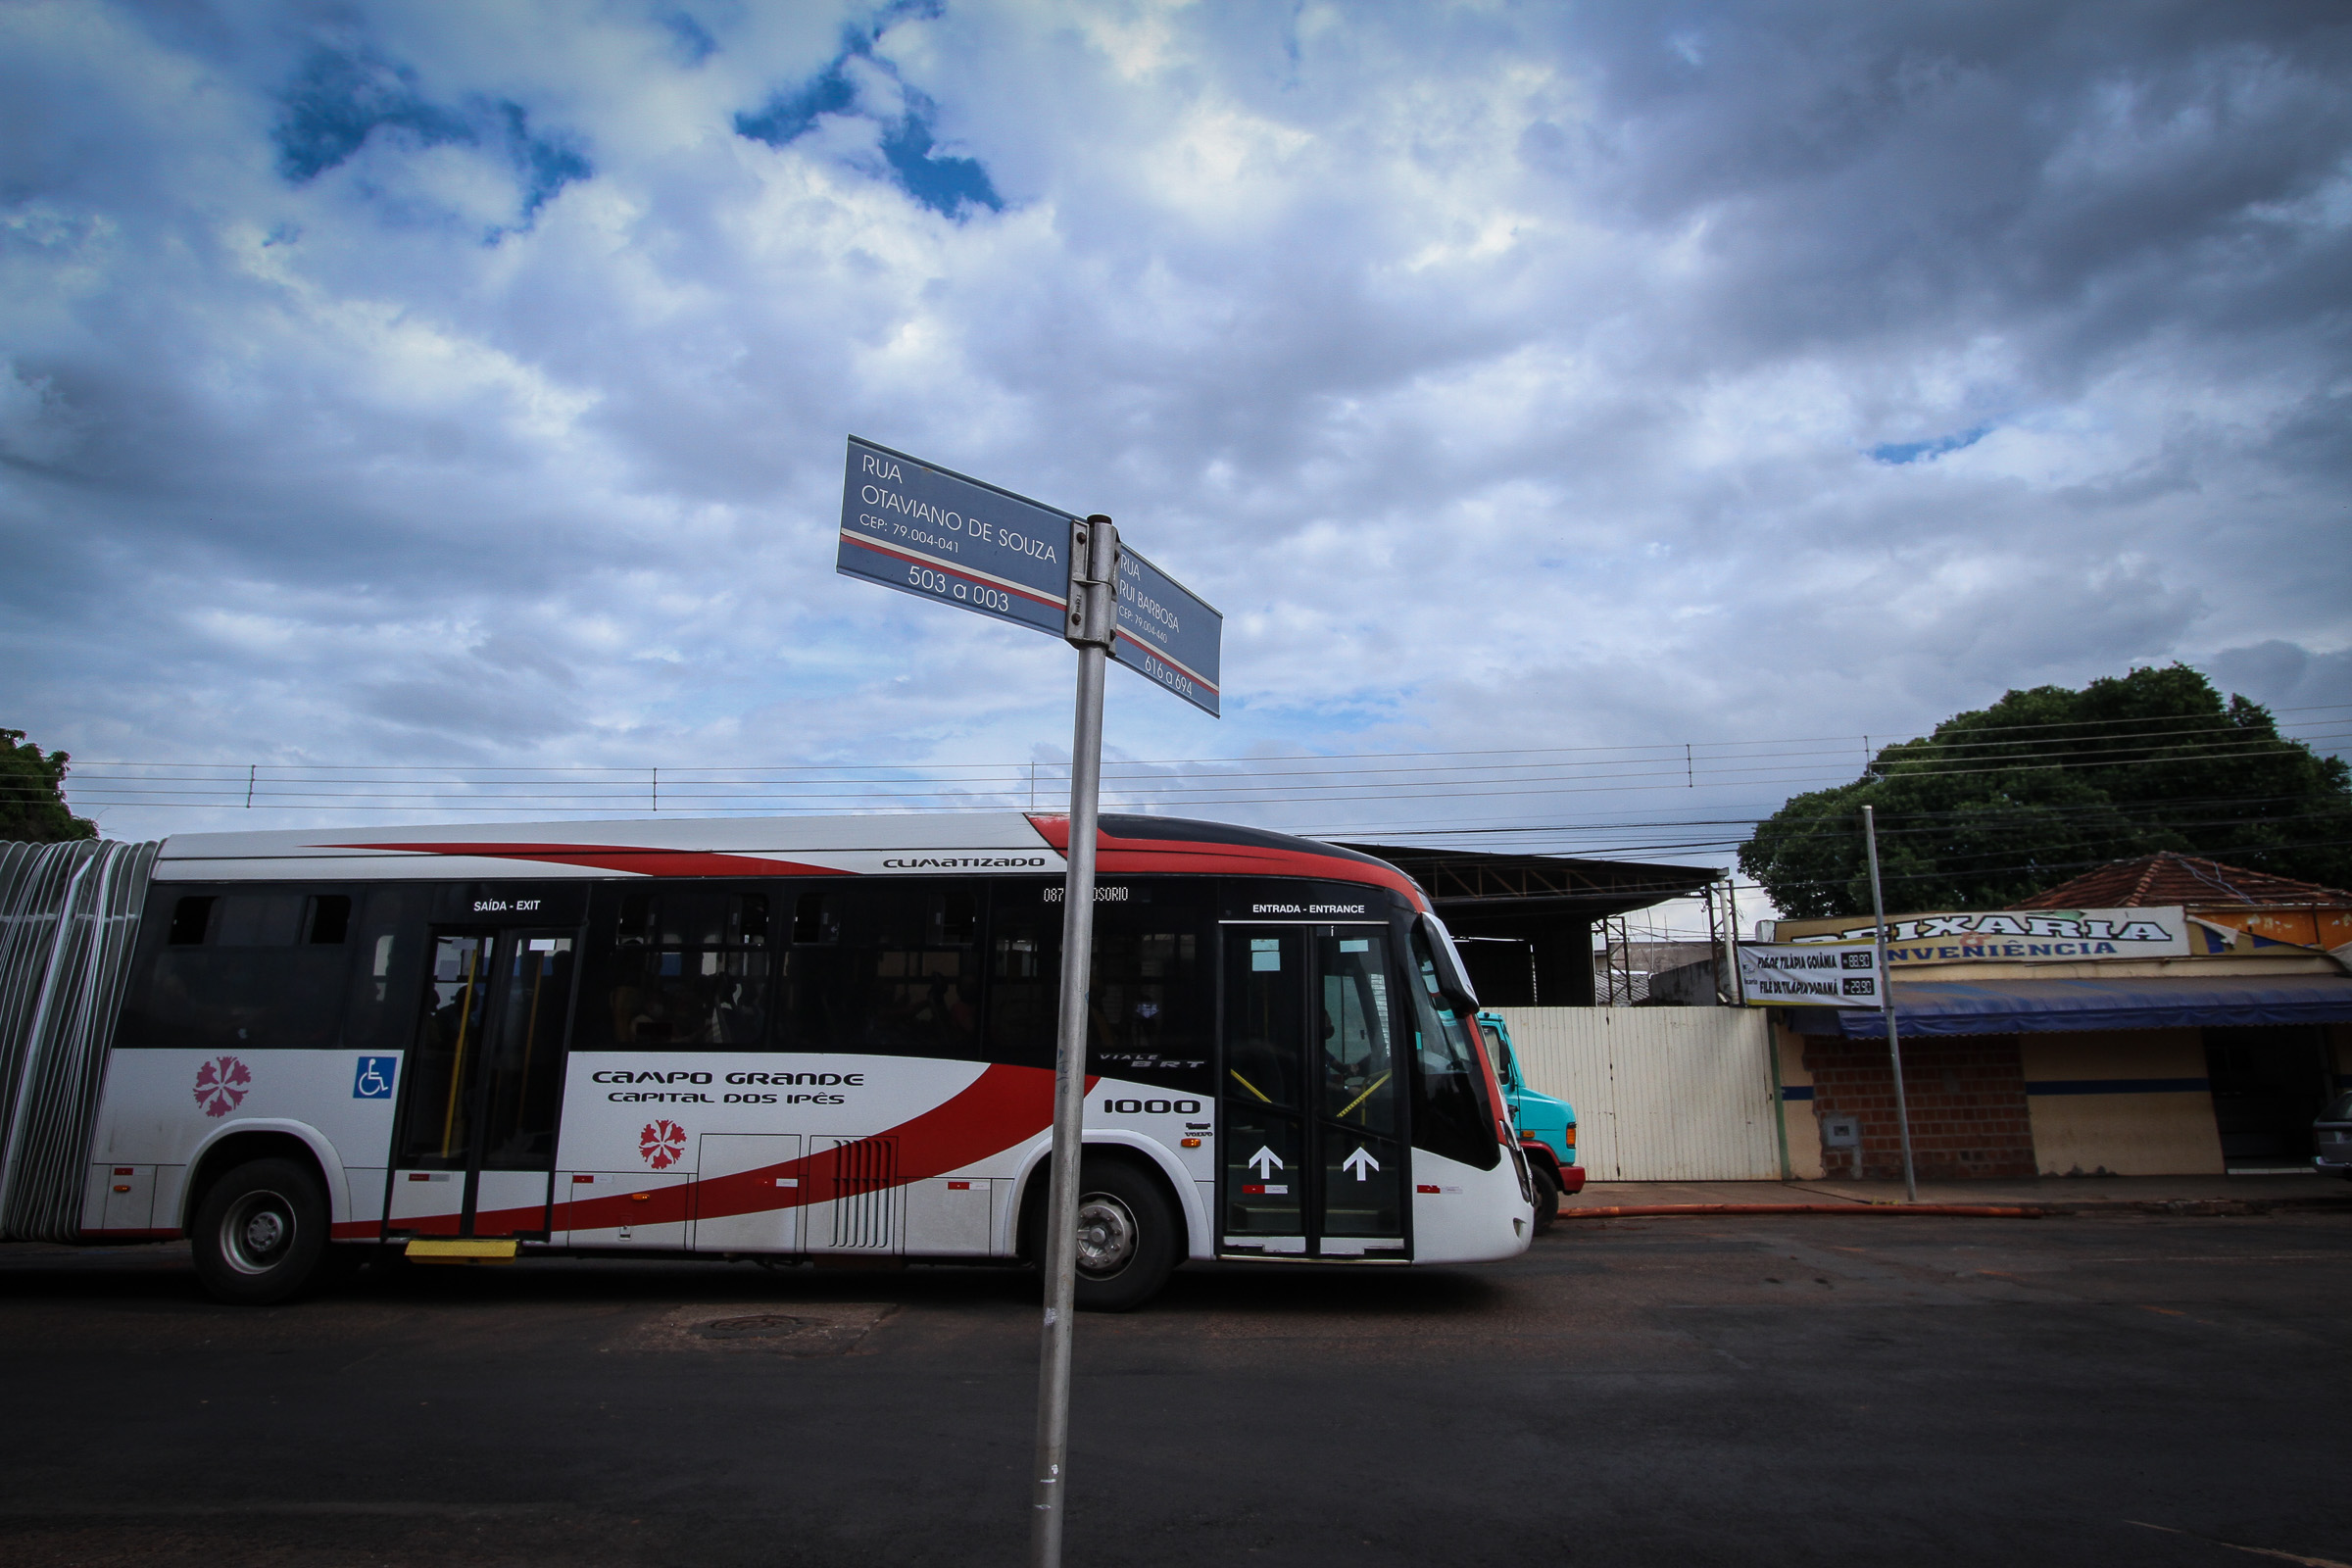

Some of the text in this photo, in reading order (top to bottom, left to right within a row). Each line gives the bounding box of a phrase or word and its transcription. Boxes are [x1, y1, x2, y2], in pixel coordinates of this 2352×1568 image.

[862, 454, 903, 484] RUA
[859, 513, 959, 554] CEP: 79.004-041
[861, 484, 1057, 564] OTAVIANO DE SOUZA
[1120, 553, 1141, 581] RUA
[907, 565, 1009, 612] 503 a 003
[1118, 605, 1134, 622] CEP:
[1119, 579, 1180, 633] RUI BARBOSA
[1145, 655, 1193, 697] 616 a 694
[473, 898, 507, 911] SAÍDA
[516, 900, 541, 910] EXIT
[1043, 887, 1064, 902] 087
[1252, 904, 1301, 913] ENTRADA
[1309, 905, 1365, 913] ENTRANCE
[724, 1093, 777, 1104] DOS
[787, 1091, 845, 1104] IPÊS
[1104, 1099, 1200, 1114] 1000
